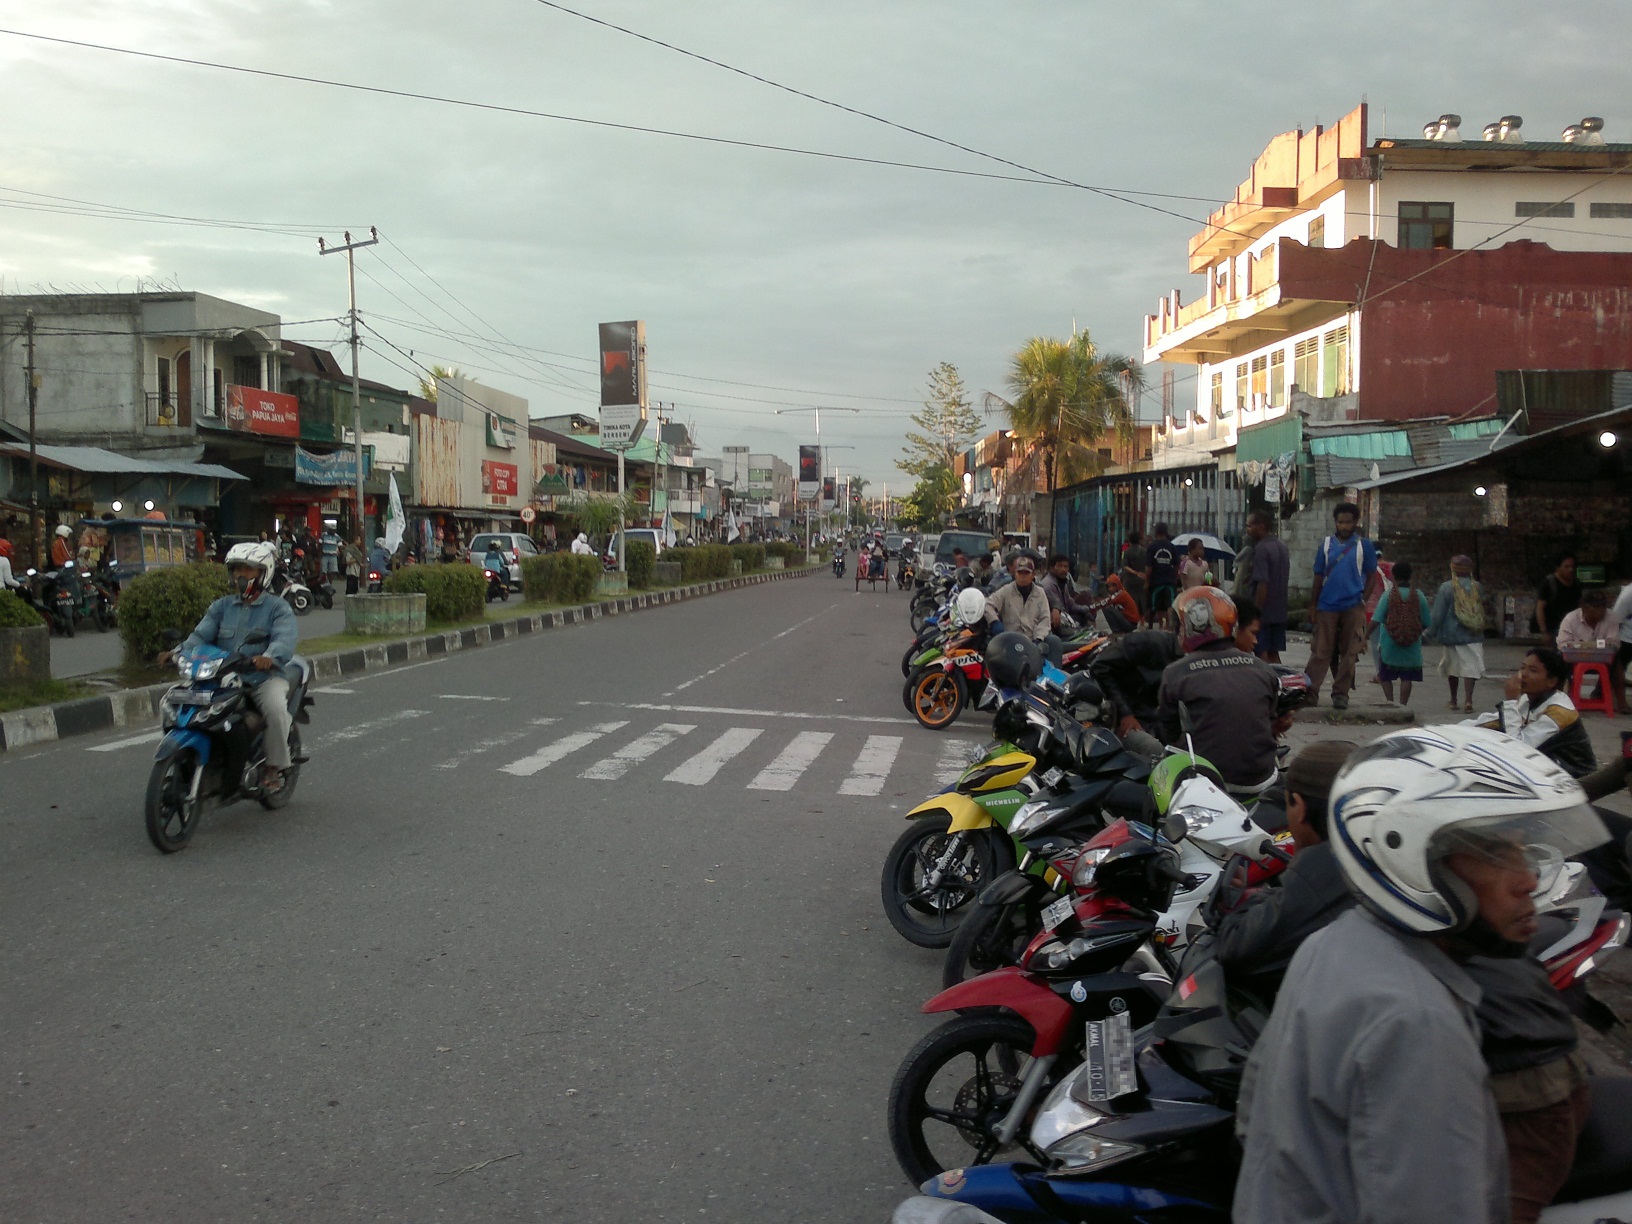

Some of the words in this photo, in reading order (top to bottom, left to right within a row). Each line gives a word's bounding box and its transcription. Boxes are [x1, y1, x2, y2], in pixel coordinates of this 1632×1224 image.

[259, 401, 275, 411] TOKO
[252, 410, 270, 421] PAPUA
[271, 413, 285, 423] JAYA
[1189, 658, 1219, 671] astra
[1220, 655, 1254, 667] motor
[985, 798, 1020, 807] MICHELIN
[1089, 1023, 1100, 1048] AKMAL
